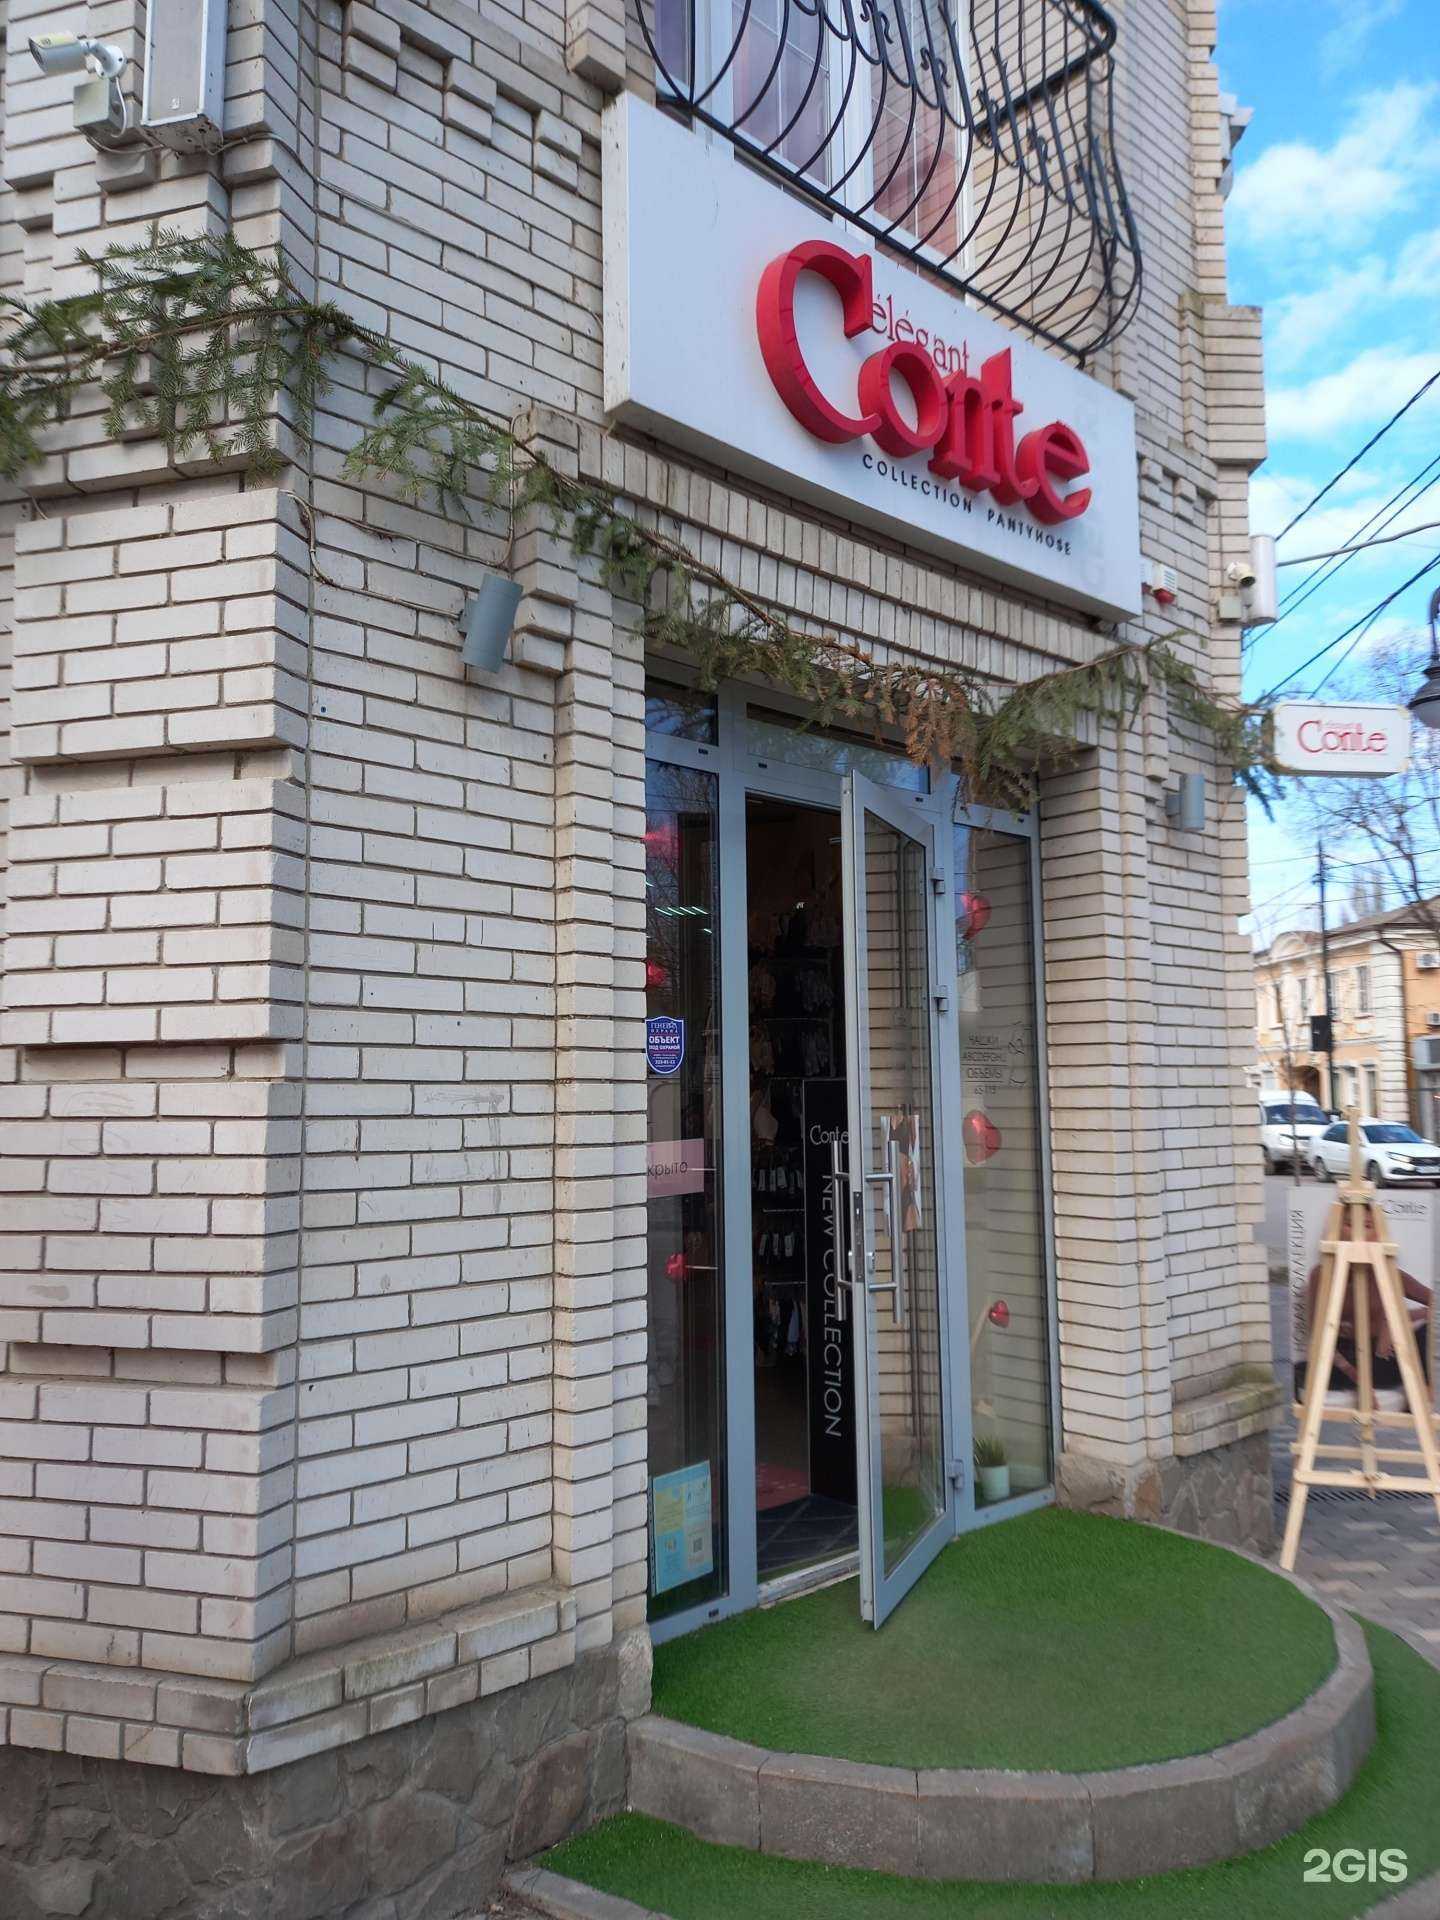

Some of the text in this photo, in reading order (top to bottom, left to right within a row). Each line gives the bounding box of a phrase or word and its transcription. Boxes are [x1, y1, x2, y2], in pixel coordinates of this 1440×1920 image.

[756, 239, 1093, 526] Conte
[862, 453, 1073, 556] COLLECTION PANTYHOSE
[1297, 719, 1388, 754] Conte
[648, 1036, 680, 1044] ОБЪЕКТ
[809, 1124, 848, 1145] Conte
[823, 1249, 842, 1437] COLLECTION
